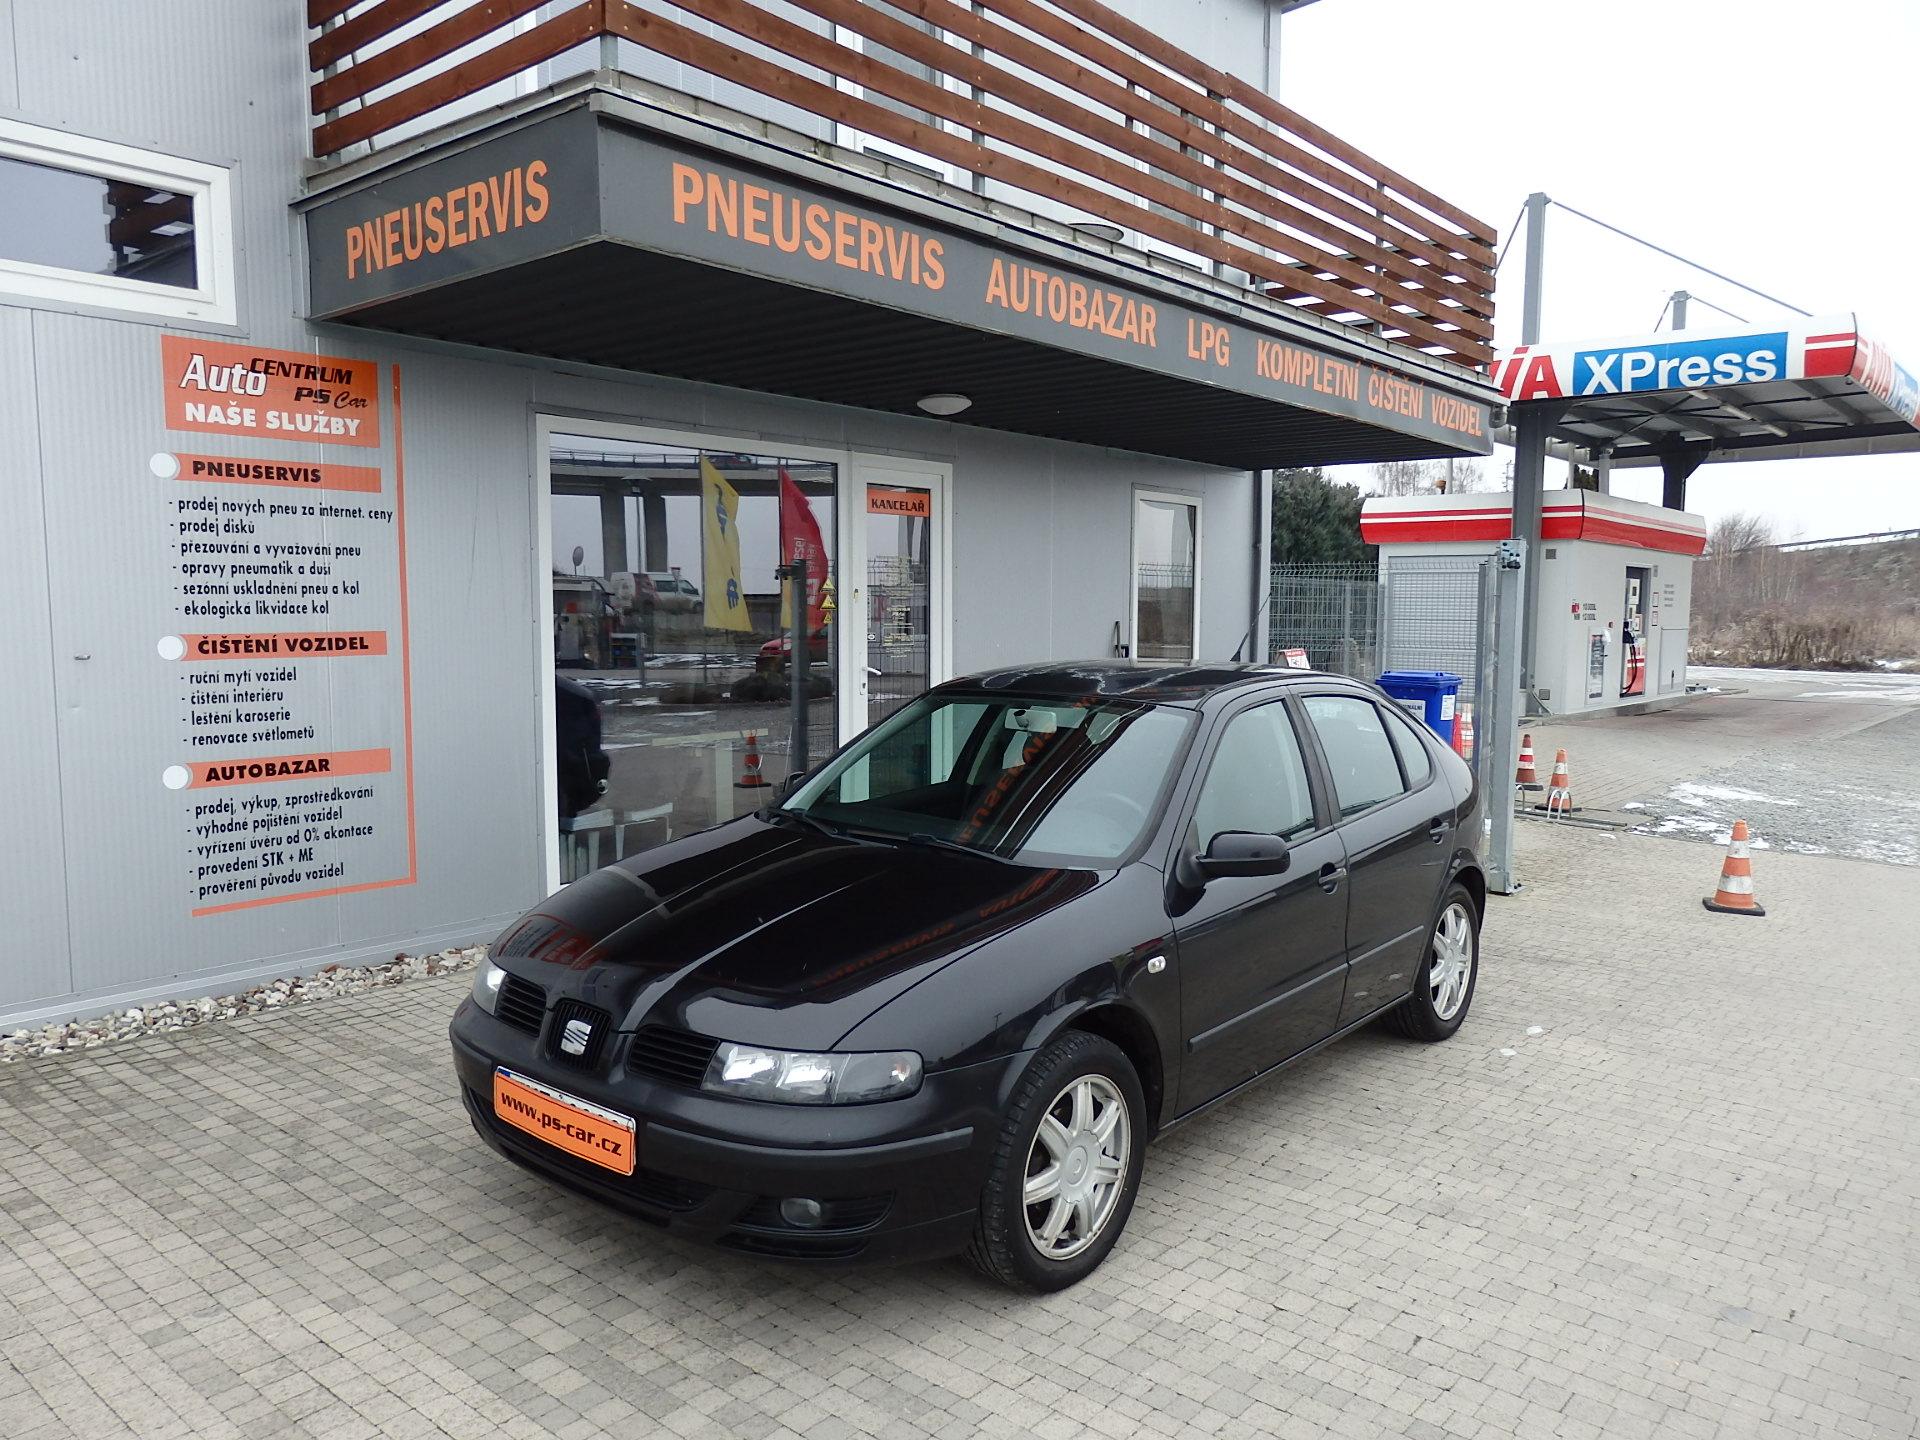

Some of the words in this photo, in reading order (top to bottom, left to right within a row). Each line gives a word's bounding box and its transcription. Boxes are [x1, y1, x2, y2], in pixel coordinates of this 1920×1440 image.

[345, 159, 549, 279] PNEUSERVIS
[672, 162, 945, 290] PNEUSERVIS
[985, 257, 1157, 348] AUTOBAZAR
[1187, 317, 1230, 367] LPG
[1256, 338, 1361, 402] KOMPLETNÍ
[1368, 363, 1425, 420] ČIŠTĚNÍ
[1431, 393, 1483, 438] VOZIDEL
[178, 352, 268, 396] Auto
[250, 357, 353, 385] CENTRUM
[1582, 349, 1777, 397] XPress
[294, 386, 331, 404] PS
[333, 391, 369, 409] Car
[184, 400, 257, 428] NAŠE
[265, 409, 361, 437] SLUŽBY
[192, 460, 322, 483] PNEUSERVIS
[178, 496, 218, 515] prodej
[222, 499, 265, 516] nových
[270, 504, 298, 517] pneu
[301, 506, 315, 516] za
[319, 502, 365, 519] internet.
[368, 509, 393, 523] ceny
[179, 517, 219, 537] prodej
[180, 540, 249, 557] přezouvání
[253, 545, 261, 555] a
[265, 542, 332, 559] vyvažování
[335, 546, 361, 559] pneu
[182, 564, 226, 578] opravy
[230, 560, 294, 578] pneumatik
[298, 565, 305, 575] a
[183, 581, 230, 595] sezónní
[233, 579, 298, 595] uskladnění
[301, 585, 328, 598] pneu
[332, 585, 339, 595] a
[342, 580, 360, 595] kol
[184, 600, 251, 619] ekologická
[255, 599, 308, 615] likvidace
[311, 599, 329, 614] kol
[197, 635, 278, 655] ČIŠTĚNÍ
[285, 637, 369, 652] VOZIDEL
[189, 670, 220, 685] ruční
[224, 669, 252, 687] mytí
[256, 666, 297, 682] vozidel
[190, 690, 230, 705] čištění
[233, 688, 284, 703] interiéru
[191, 709, 232, 726] leštění
[235, 707, 291, 724] karoserie
[192, 731, 248, 746] renovace
[252, 726, 315, 744] světlometů
[206, 758, 331, 782] AUTOBAZAR
[195, 797, 237, 819] prodej,
[241, 794, 281, 814] výkup,
[285, 785, 374, 809] zprostředkování
[196, 817, 249, 839] výhodné
[253, 812, 300, 833] pojištění
[304, 806, 343, 824] vozidel
[197, 839, 247, 859] vyřízení
[250, 833, 283, 851] úvěru
[286, 831, 300, 845] od
[304, 826, 320, 844] 0%
[324, 824, 374, 841] akontace
[198, 857, 258, 880] provedení
[262, 851, 285, 868] STK
[298, 847, 314, 864] ME
[199, 877, 257, 900] prověření
[260, 868, 302, 891] původu
[305, 861, 345, 881] vozidel
[501, 1091, 622, 1157] www.ps-car.cz
